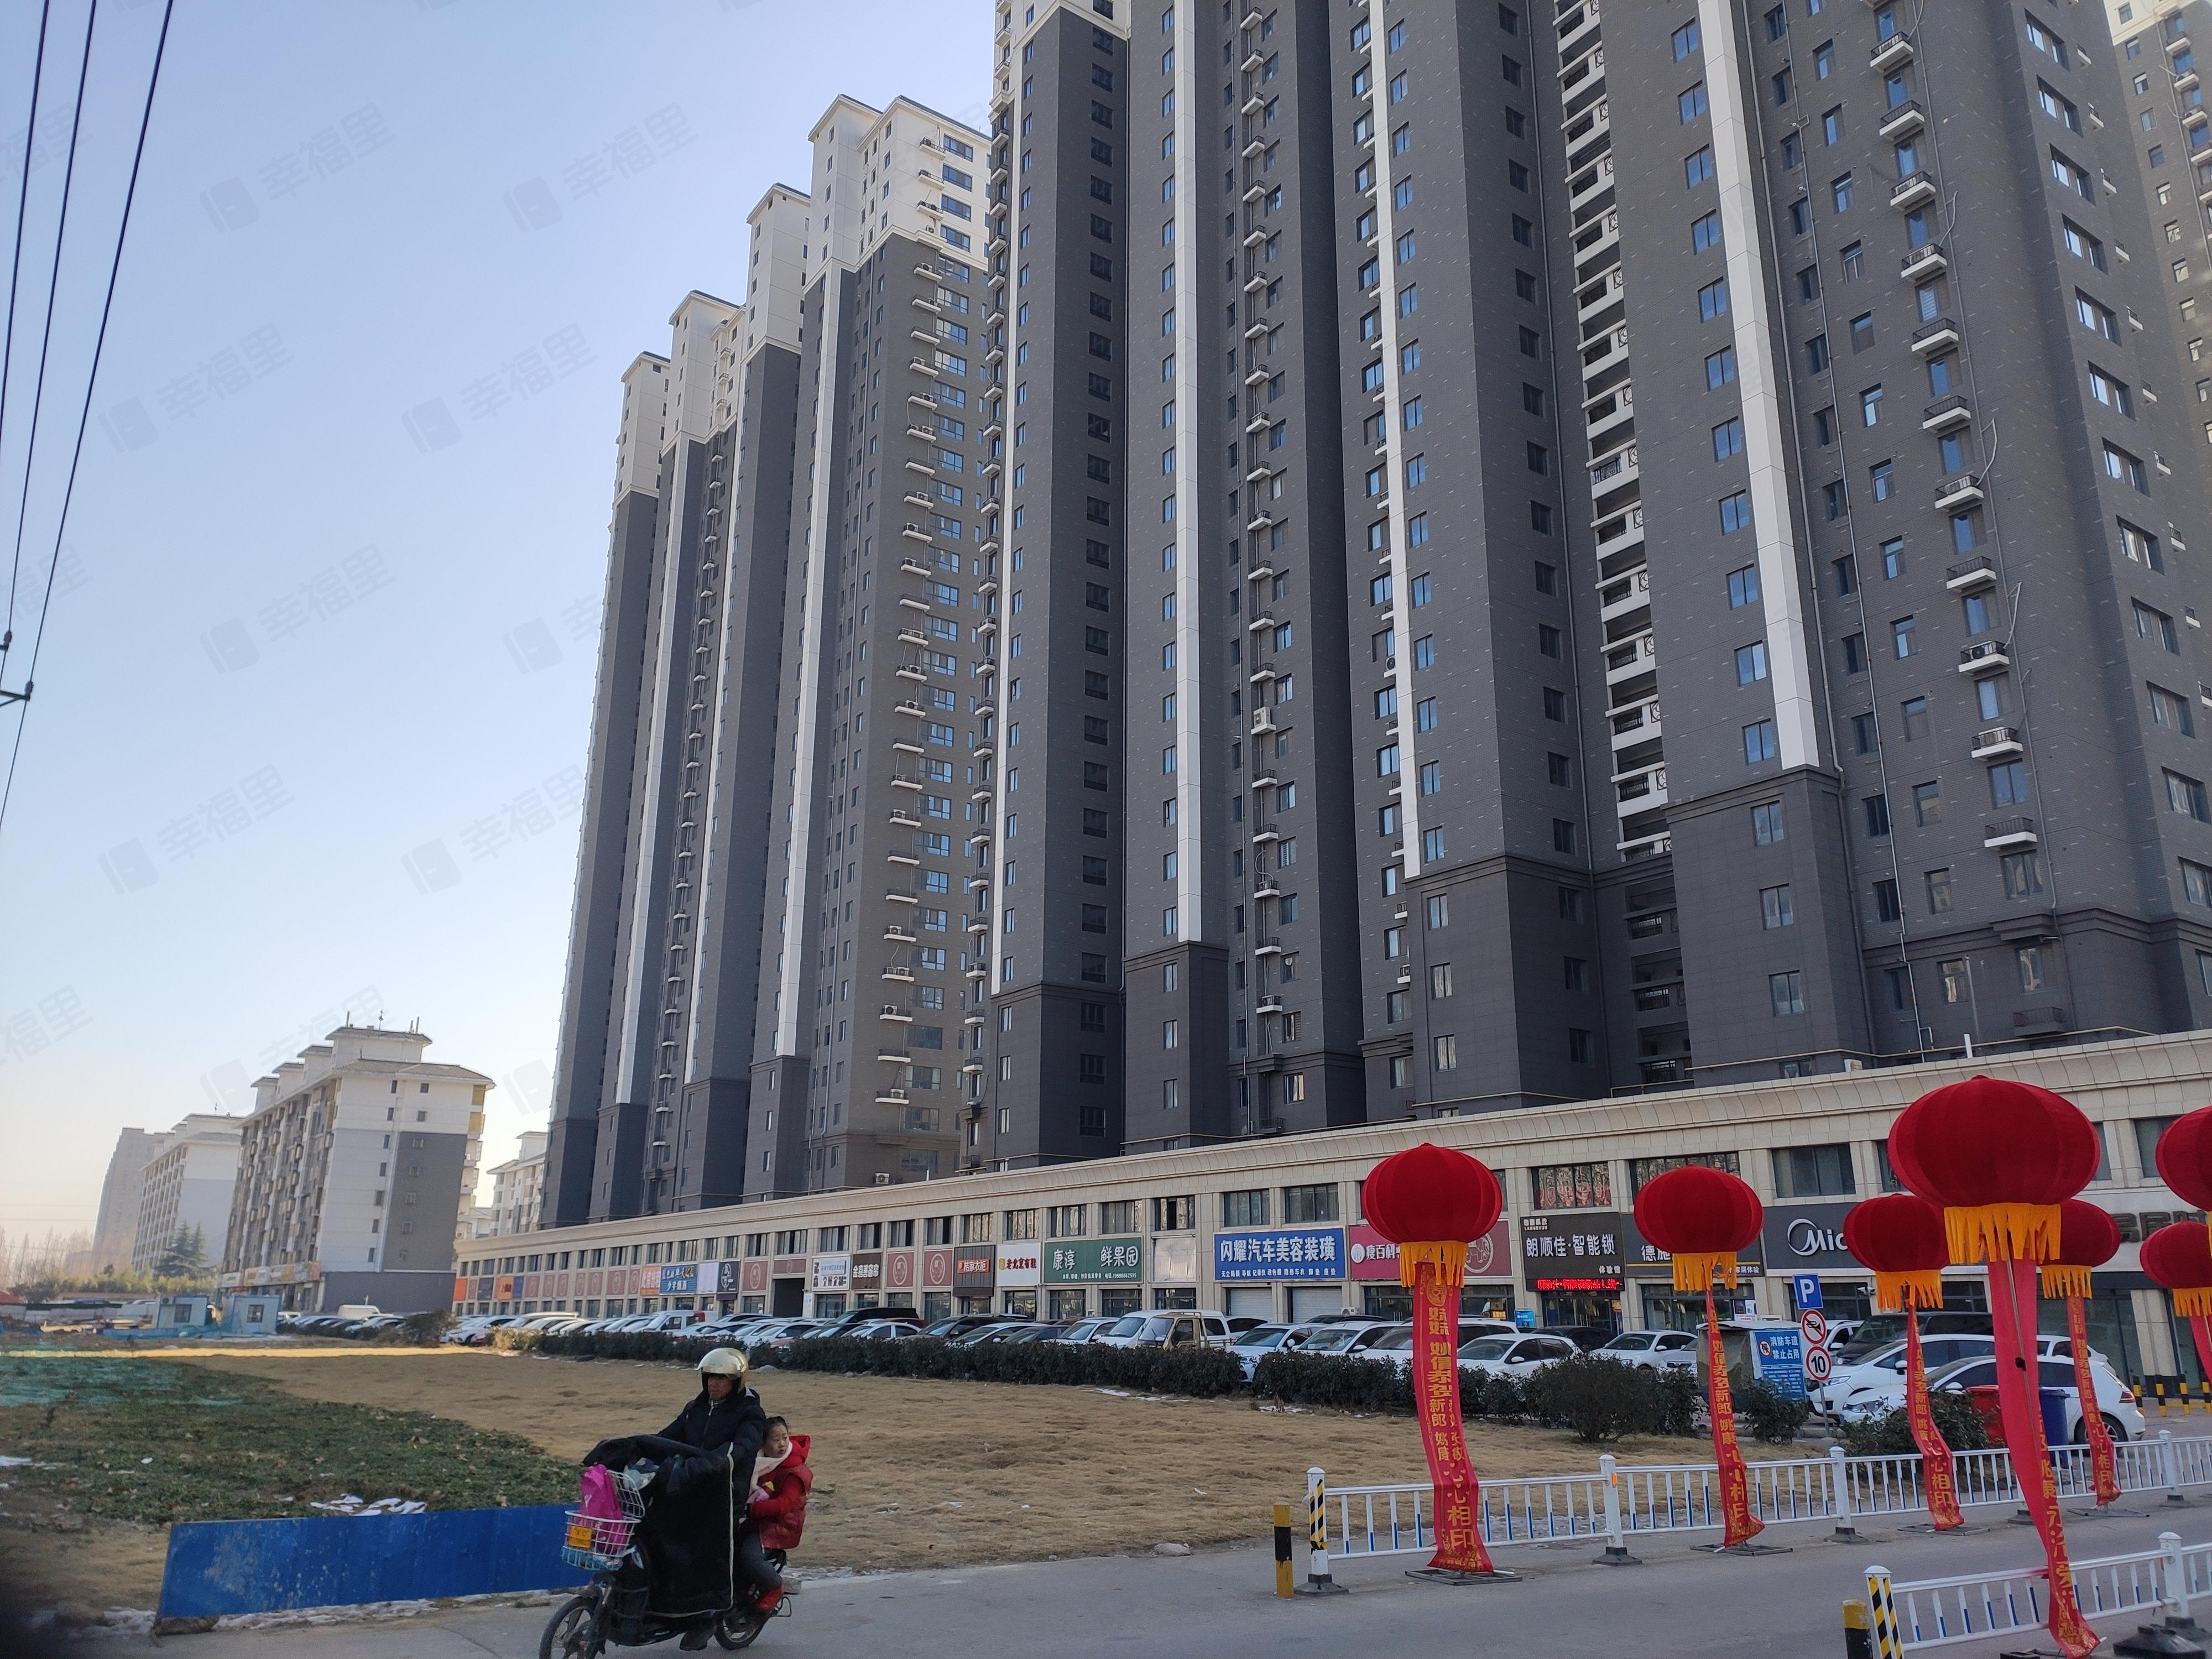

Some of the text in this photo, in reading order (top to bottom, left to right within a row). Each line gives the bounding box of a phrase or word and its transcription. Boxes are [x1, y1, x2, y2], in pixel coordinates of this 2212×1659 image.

[1100, 1245, 1139, 1267] 鲜果园
[1220, 1235, 1336, 1263] 闪耀汽车美容装璜
[1799, 1279, 1814, 1303] P
[1770, 1335, 1798, 1347] 消防车道
[1772, 1349, 1799, 1360] 禁止占用
[1811, 1355, 1826, 1373] 10
